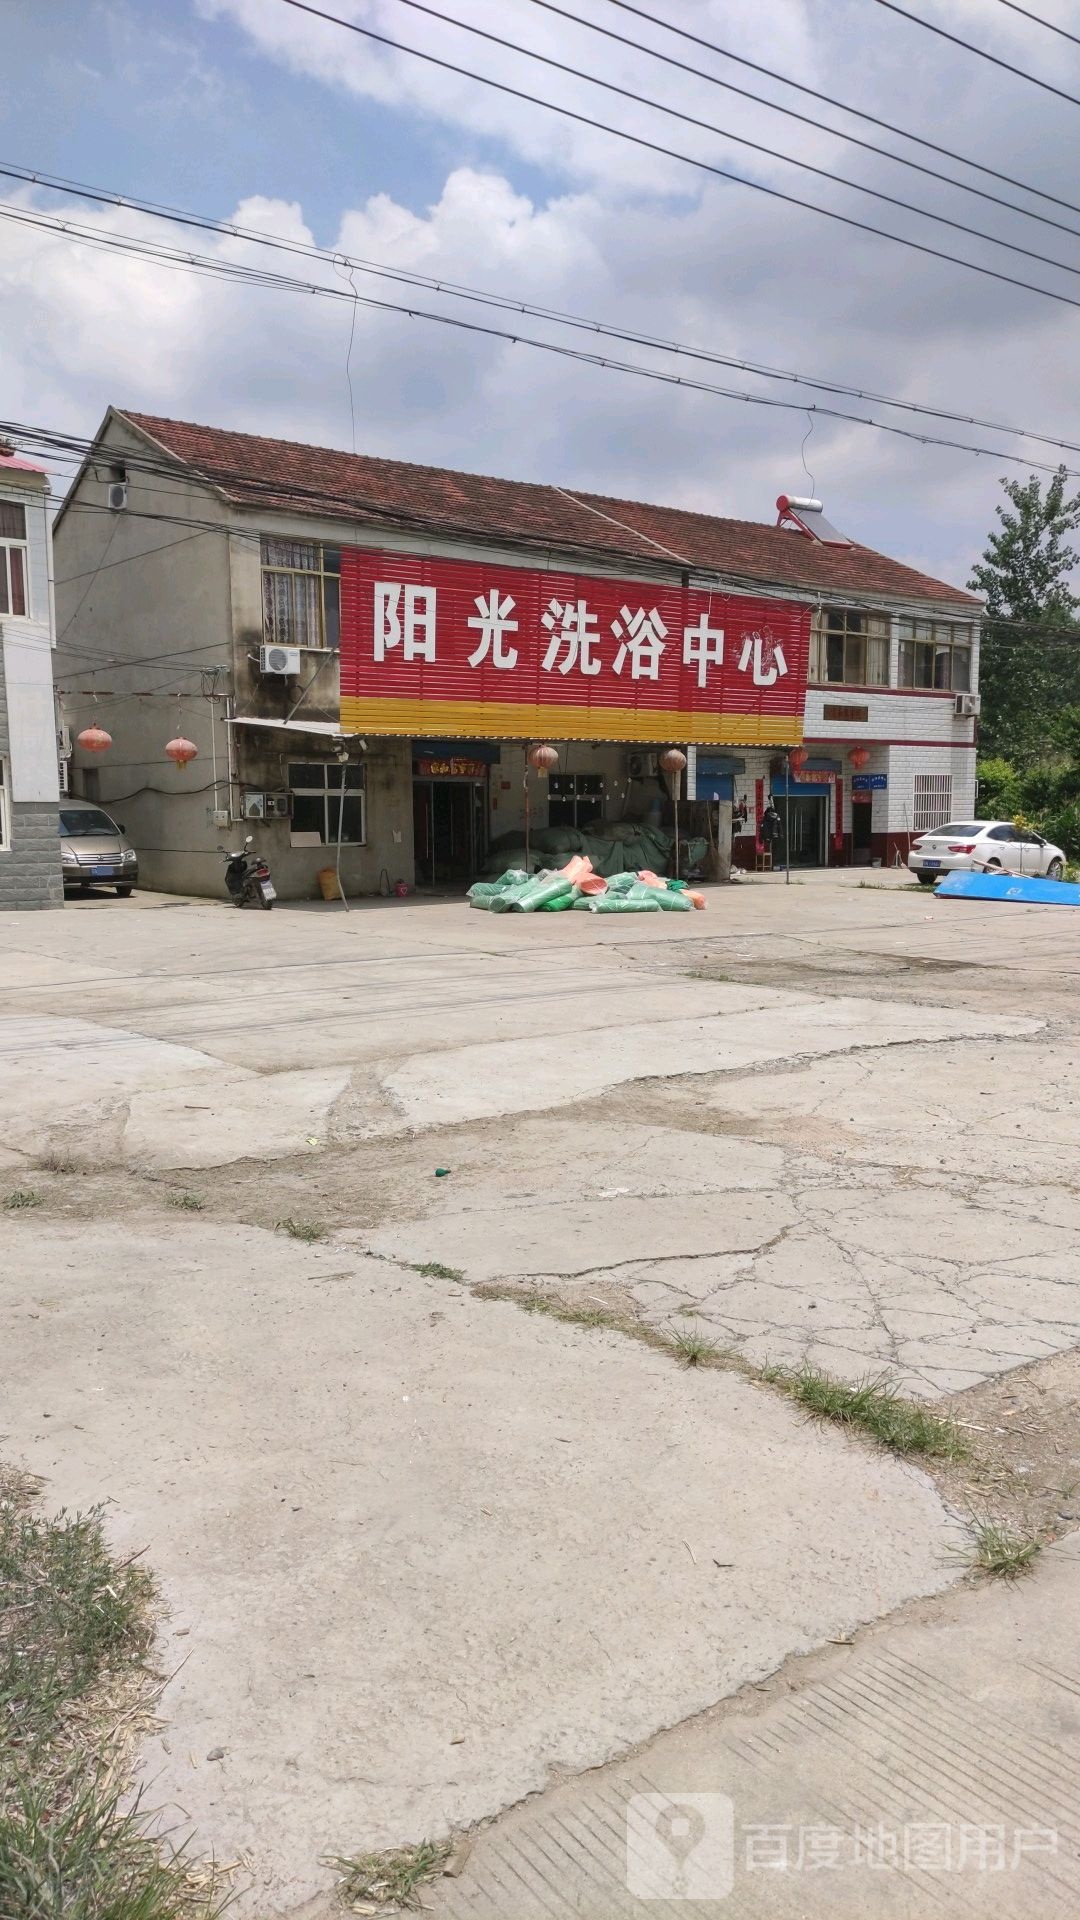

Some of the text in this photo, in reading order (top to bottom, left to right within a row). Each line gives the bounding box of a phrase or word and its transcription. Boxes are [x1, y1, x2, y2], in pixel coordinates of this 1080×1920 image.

[373, 582, 788, 688] 阳光洗浴中心
